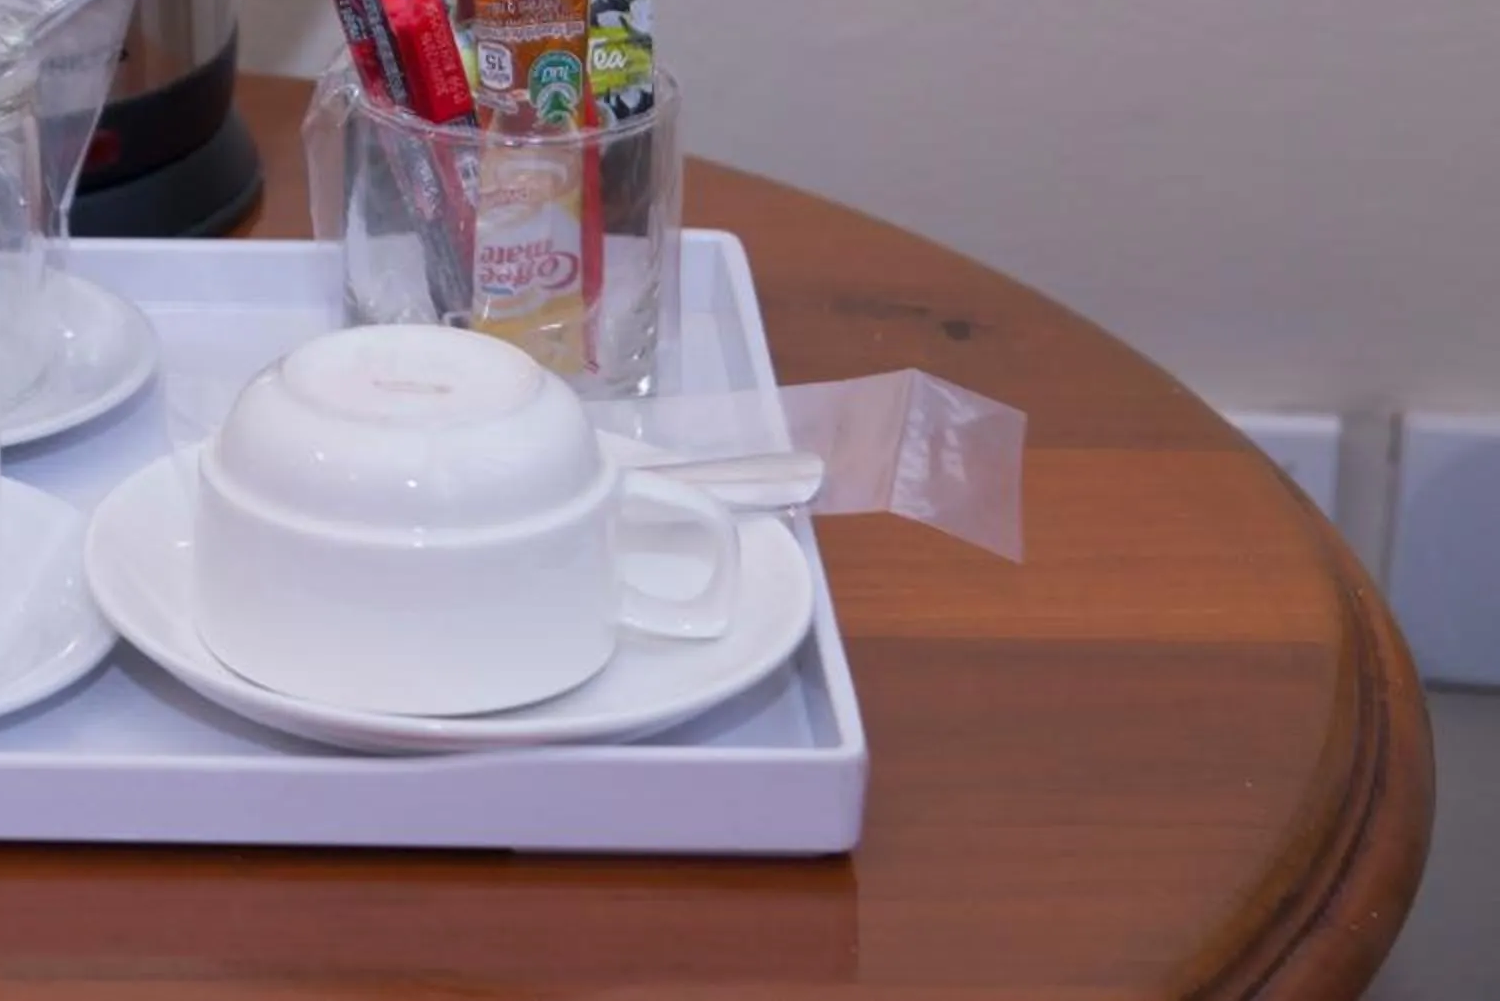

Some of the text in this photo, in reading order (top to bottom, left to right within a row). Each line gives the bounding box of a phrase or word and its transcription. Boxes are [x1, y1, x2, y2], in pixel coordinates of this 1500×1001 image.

[485, 54, 506, 72] 15
[481, 238, 554, 264] mate
[480, 250, 579, 290] Coffee
